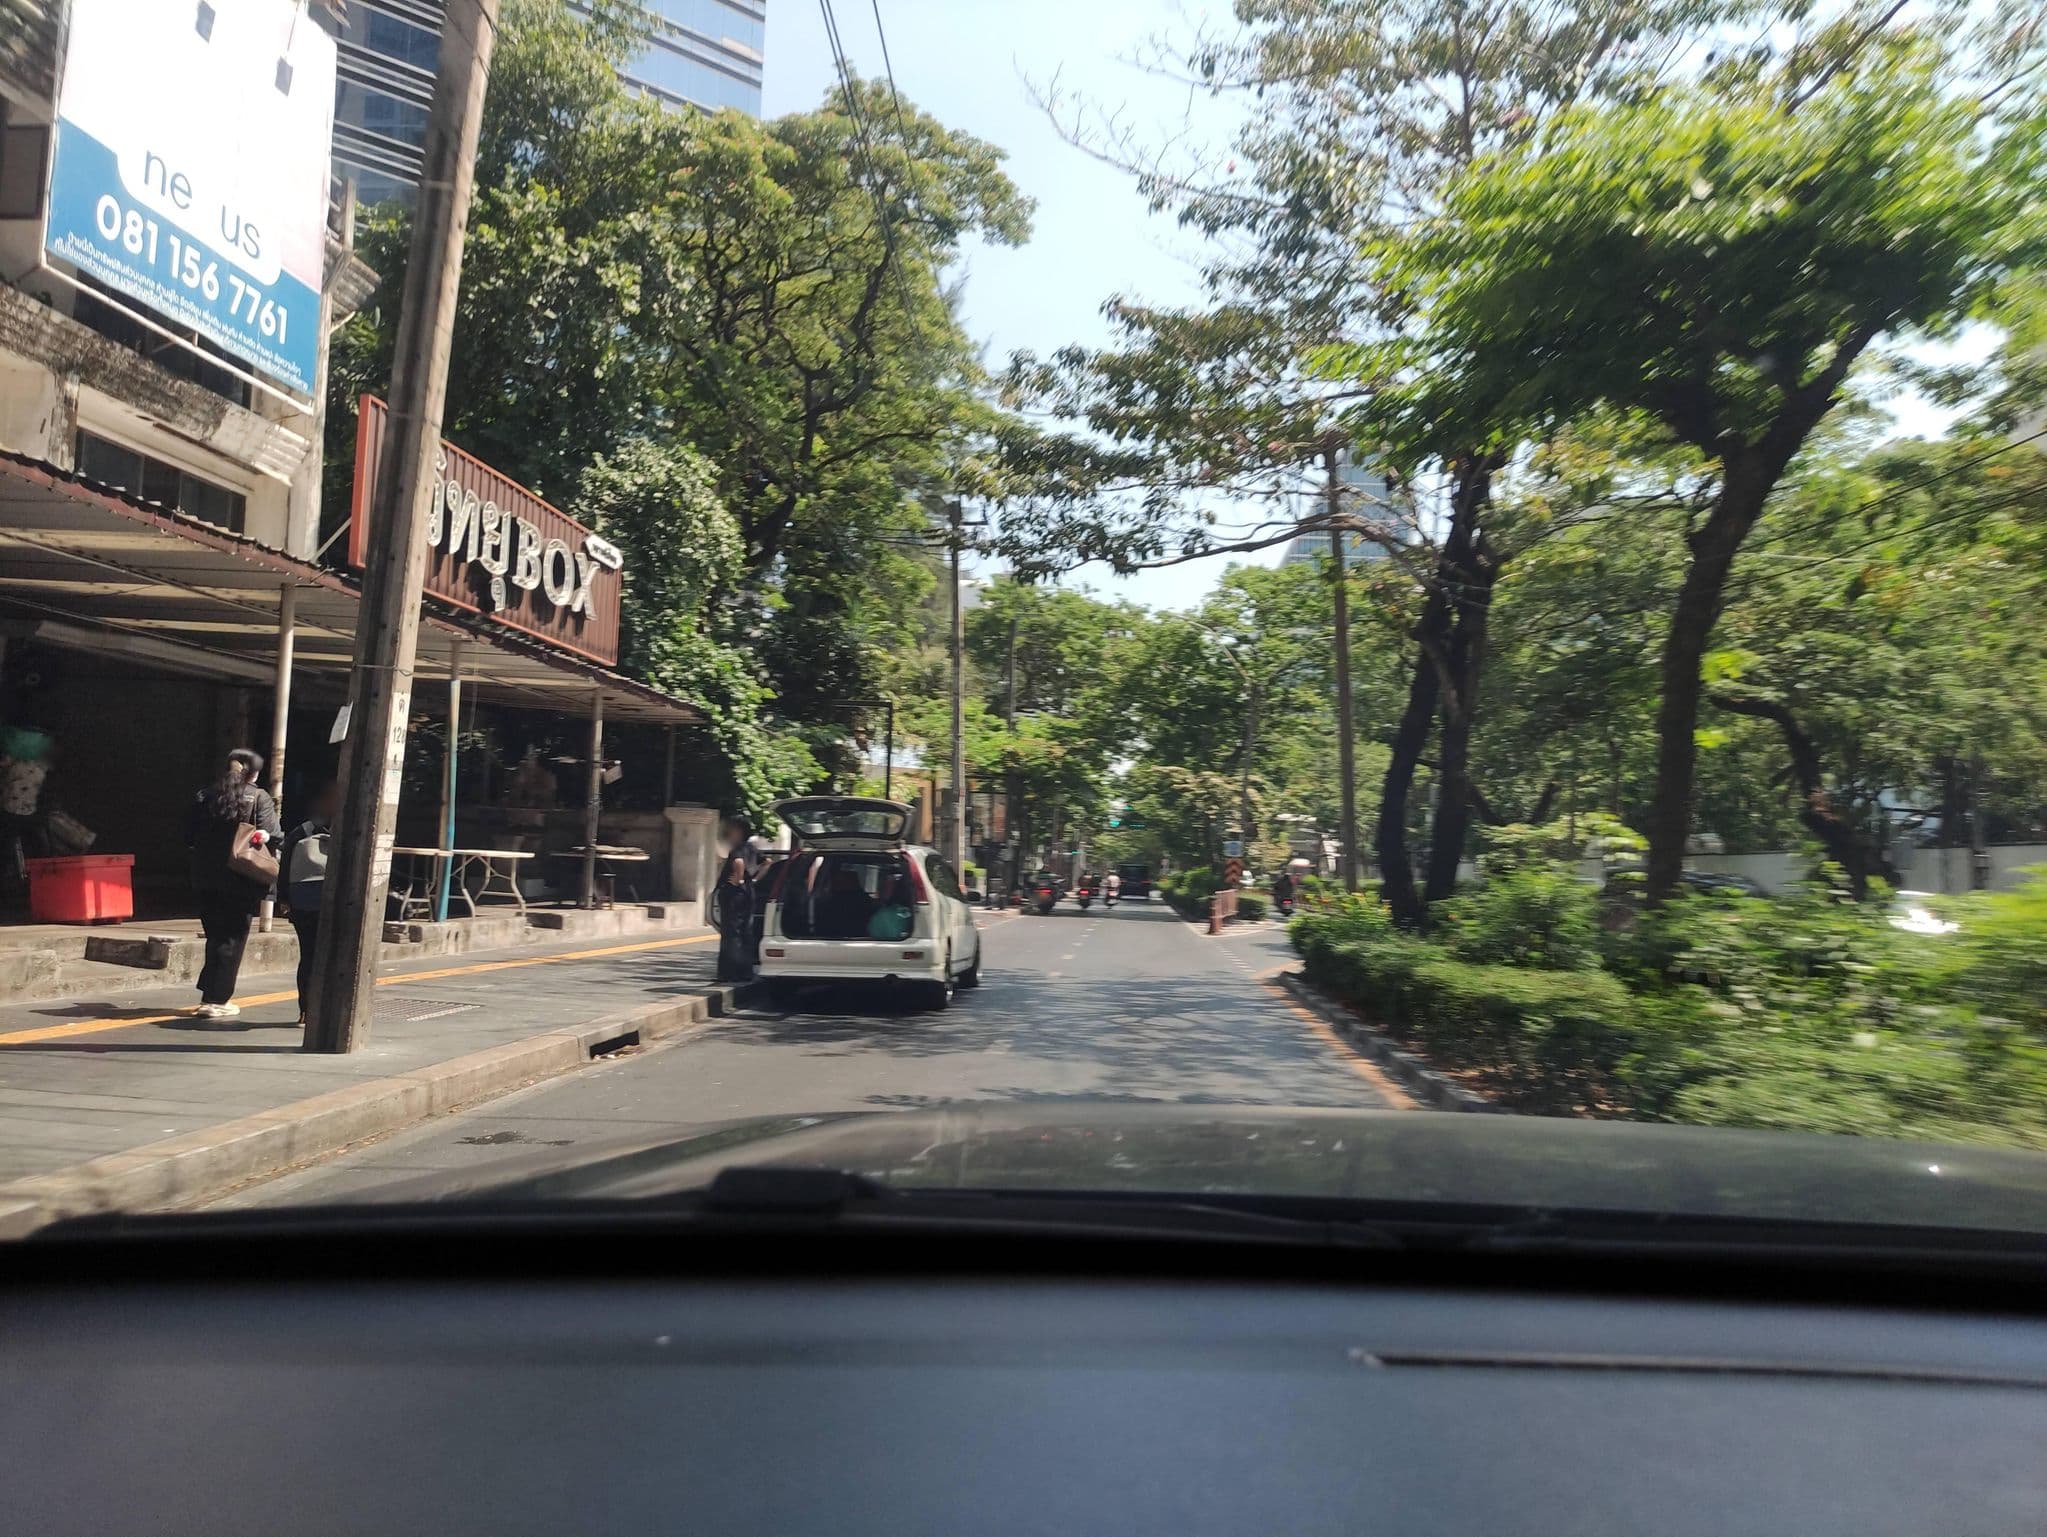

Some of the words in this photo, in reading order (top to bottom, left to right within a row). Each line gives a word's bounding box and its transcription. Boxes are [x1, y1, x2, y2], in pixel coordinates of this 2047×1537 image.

[96, 193, 159, 265] 081
[169, 233, 220, 301] 156
[228, 274, 288, 346] 7761
[512, 516, 601, 621] BOX
